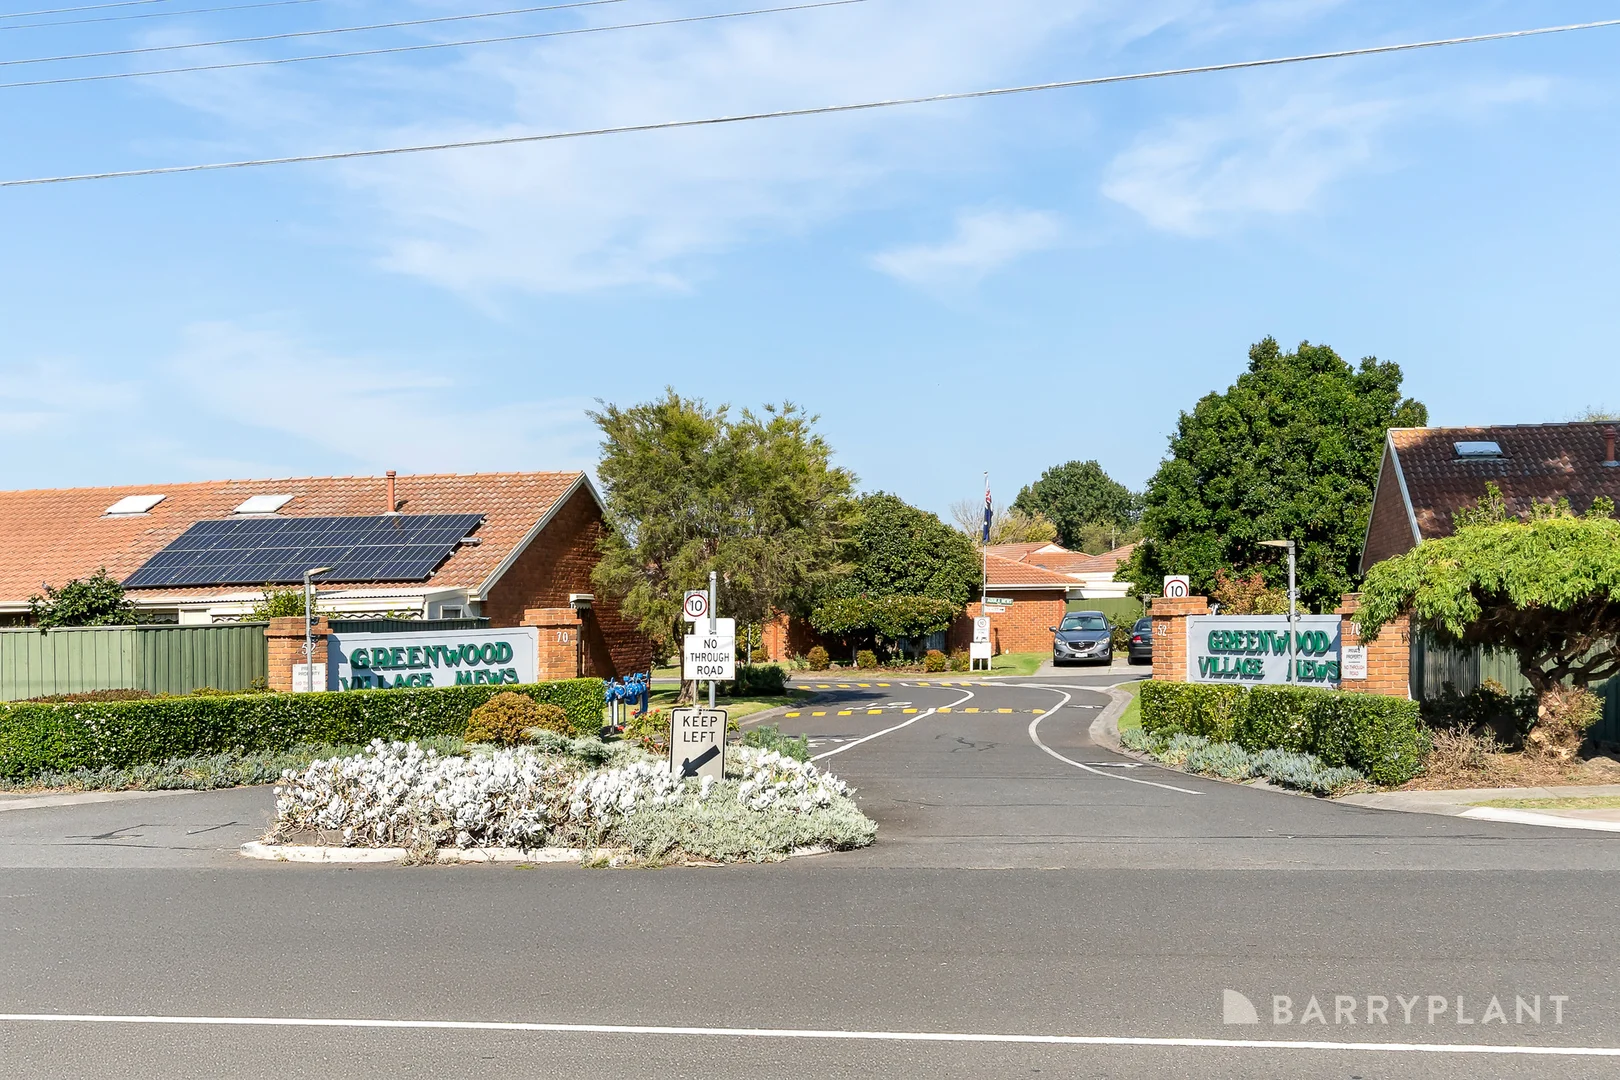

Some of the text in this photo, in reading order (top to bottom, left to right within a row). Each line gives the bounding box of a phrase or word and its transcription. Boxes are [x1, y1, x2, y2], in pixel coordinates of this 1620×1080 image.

[1171, 585, 1183, 597] 10
[690, 600, 703, 612] 10
[1158, 624, 1167, 636] 52
[556, 631, 569, 643] 70
[1208, 630, 1331, 655] GREENWOOD
[703, 639, 718, 649] NO
[350, 641, 514, 671] GREENWOOD
[690, 652, 730, 662] THROUGH
[696, 665, 724, 676] ROAD
[1198, 656, 1265, 679] VILLAGE
[455, 667, 519, 685] MEWS
[683, 715, 718, 727] KEEP
[683, 731, 716, 742] LEFT
